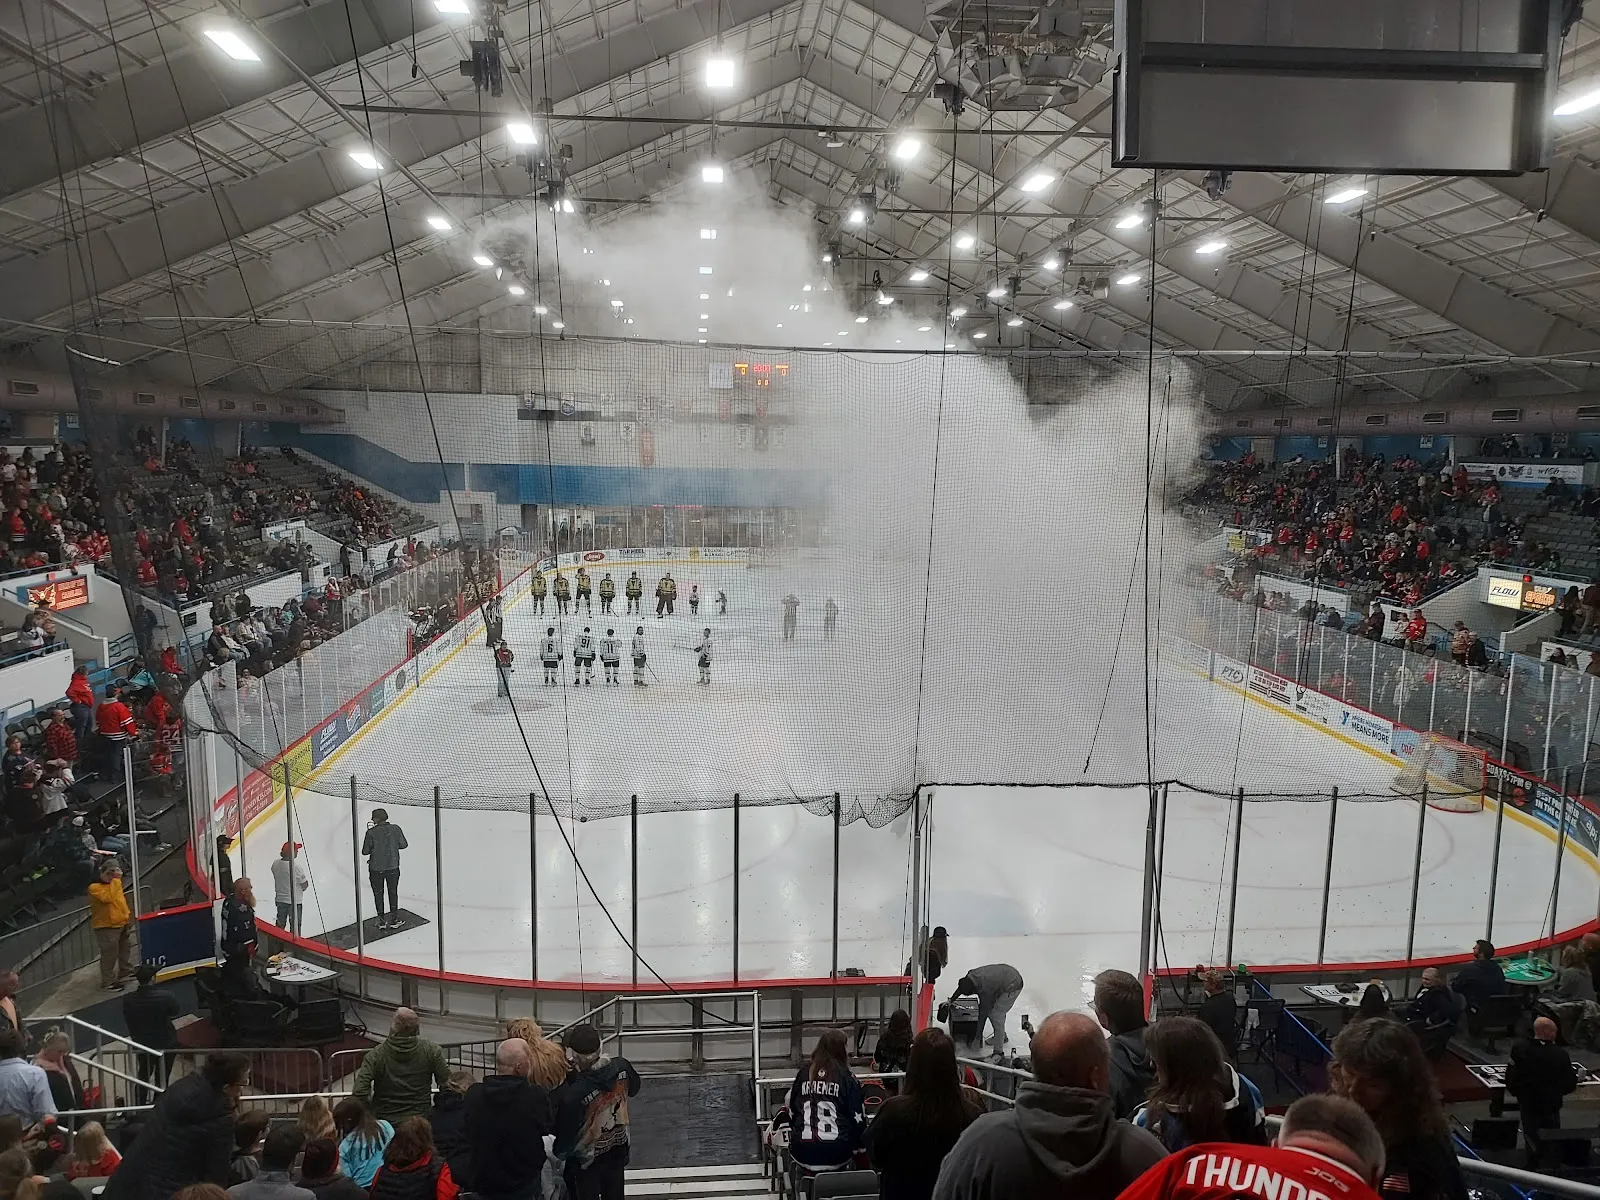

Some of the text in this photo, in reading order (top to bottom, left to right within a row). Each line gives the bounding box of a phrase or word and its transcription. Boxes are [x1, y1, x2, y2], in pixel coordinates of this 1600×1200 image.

[1491, 586, 1520, 597] FLOW
[1221, 665, 1241, 680] PTC
[161, 729, 182, 745] 24
[1351, 721, 1390, 745] MEANS MORE
[800, 1100, 840, 1141] 18
[1303, 1166, 1351, 1193] JOG
